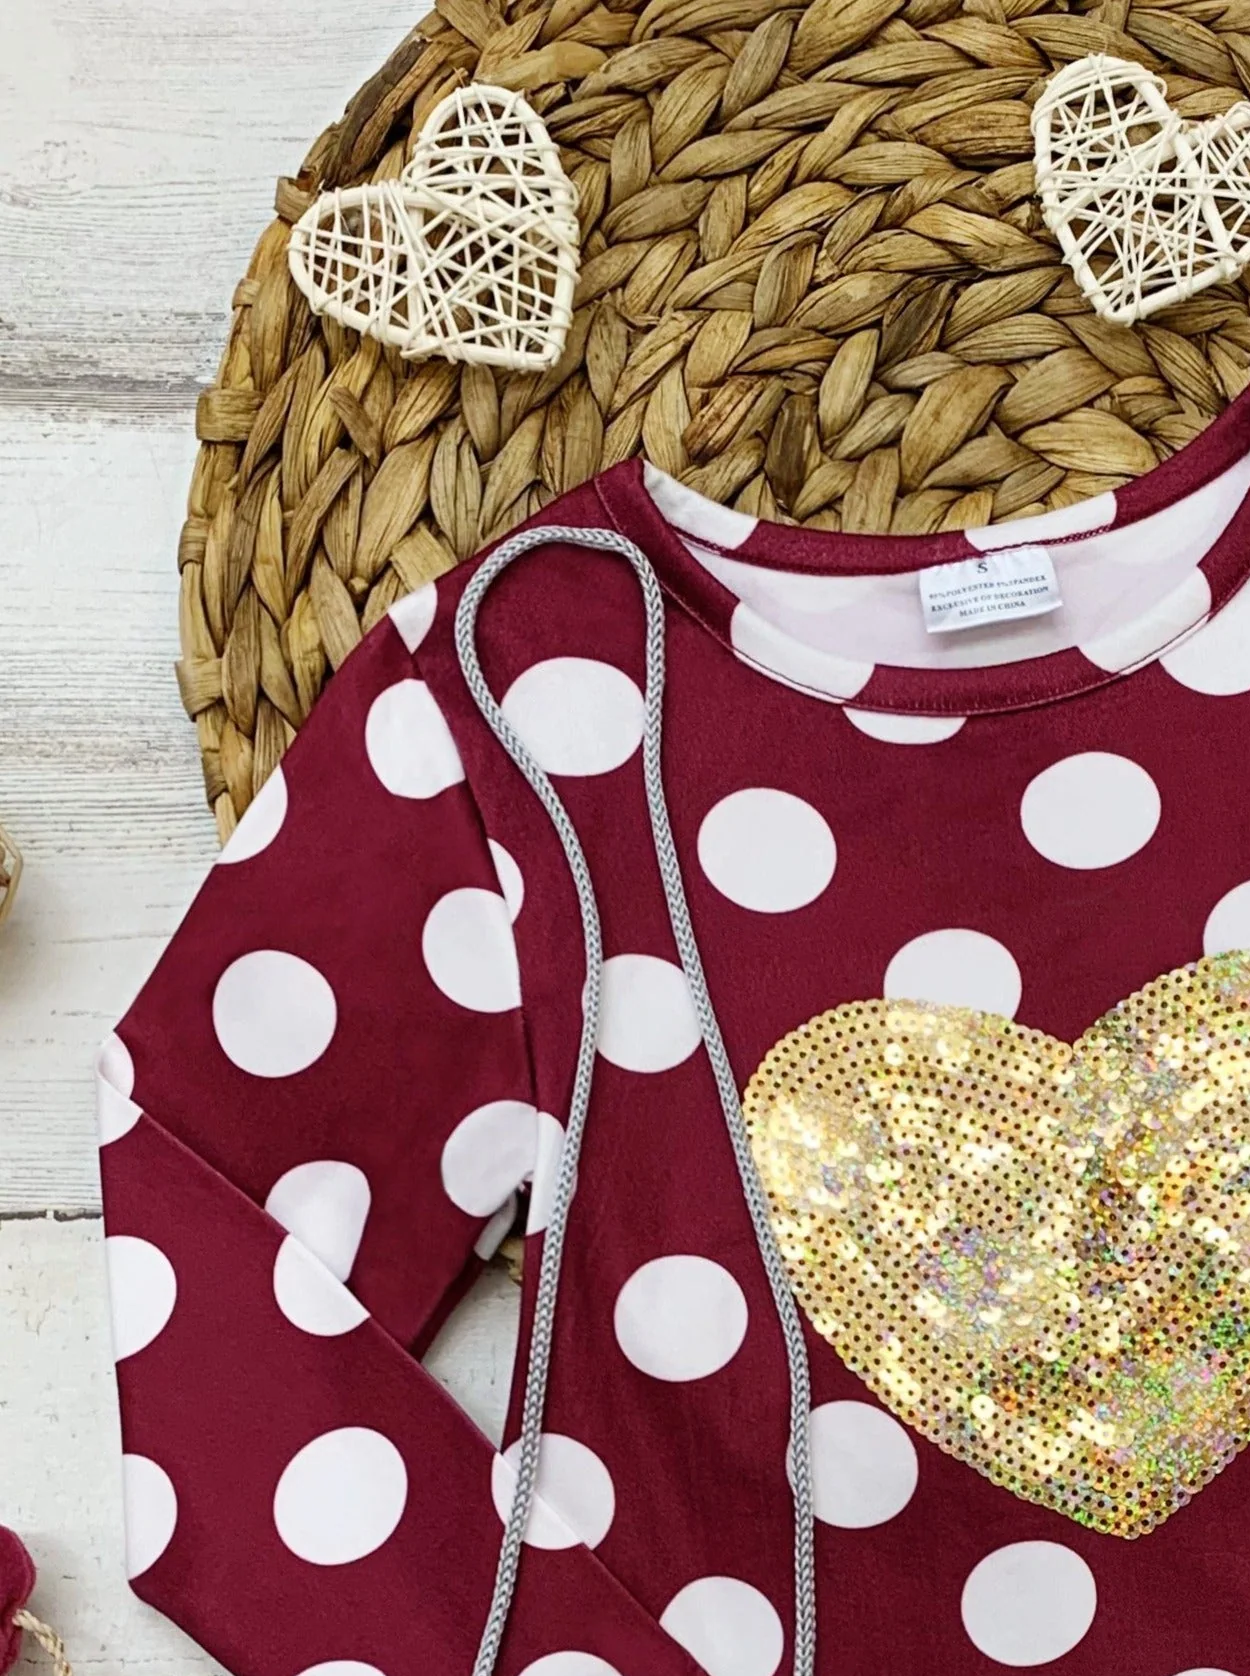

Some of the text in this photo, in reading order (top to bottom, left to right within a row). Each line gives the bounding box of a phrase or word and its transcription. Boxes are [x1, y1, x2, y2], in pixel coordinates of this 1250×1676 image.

[977, 562, 989, 574] S
[931, 596, 978, 612] EXCLUSIVE
[993, 586, 1049, 600] DECORATION
[959, 601, 1026, 617] MADE IN CHINA
